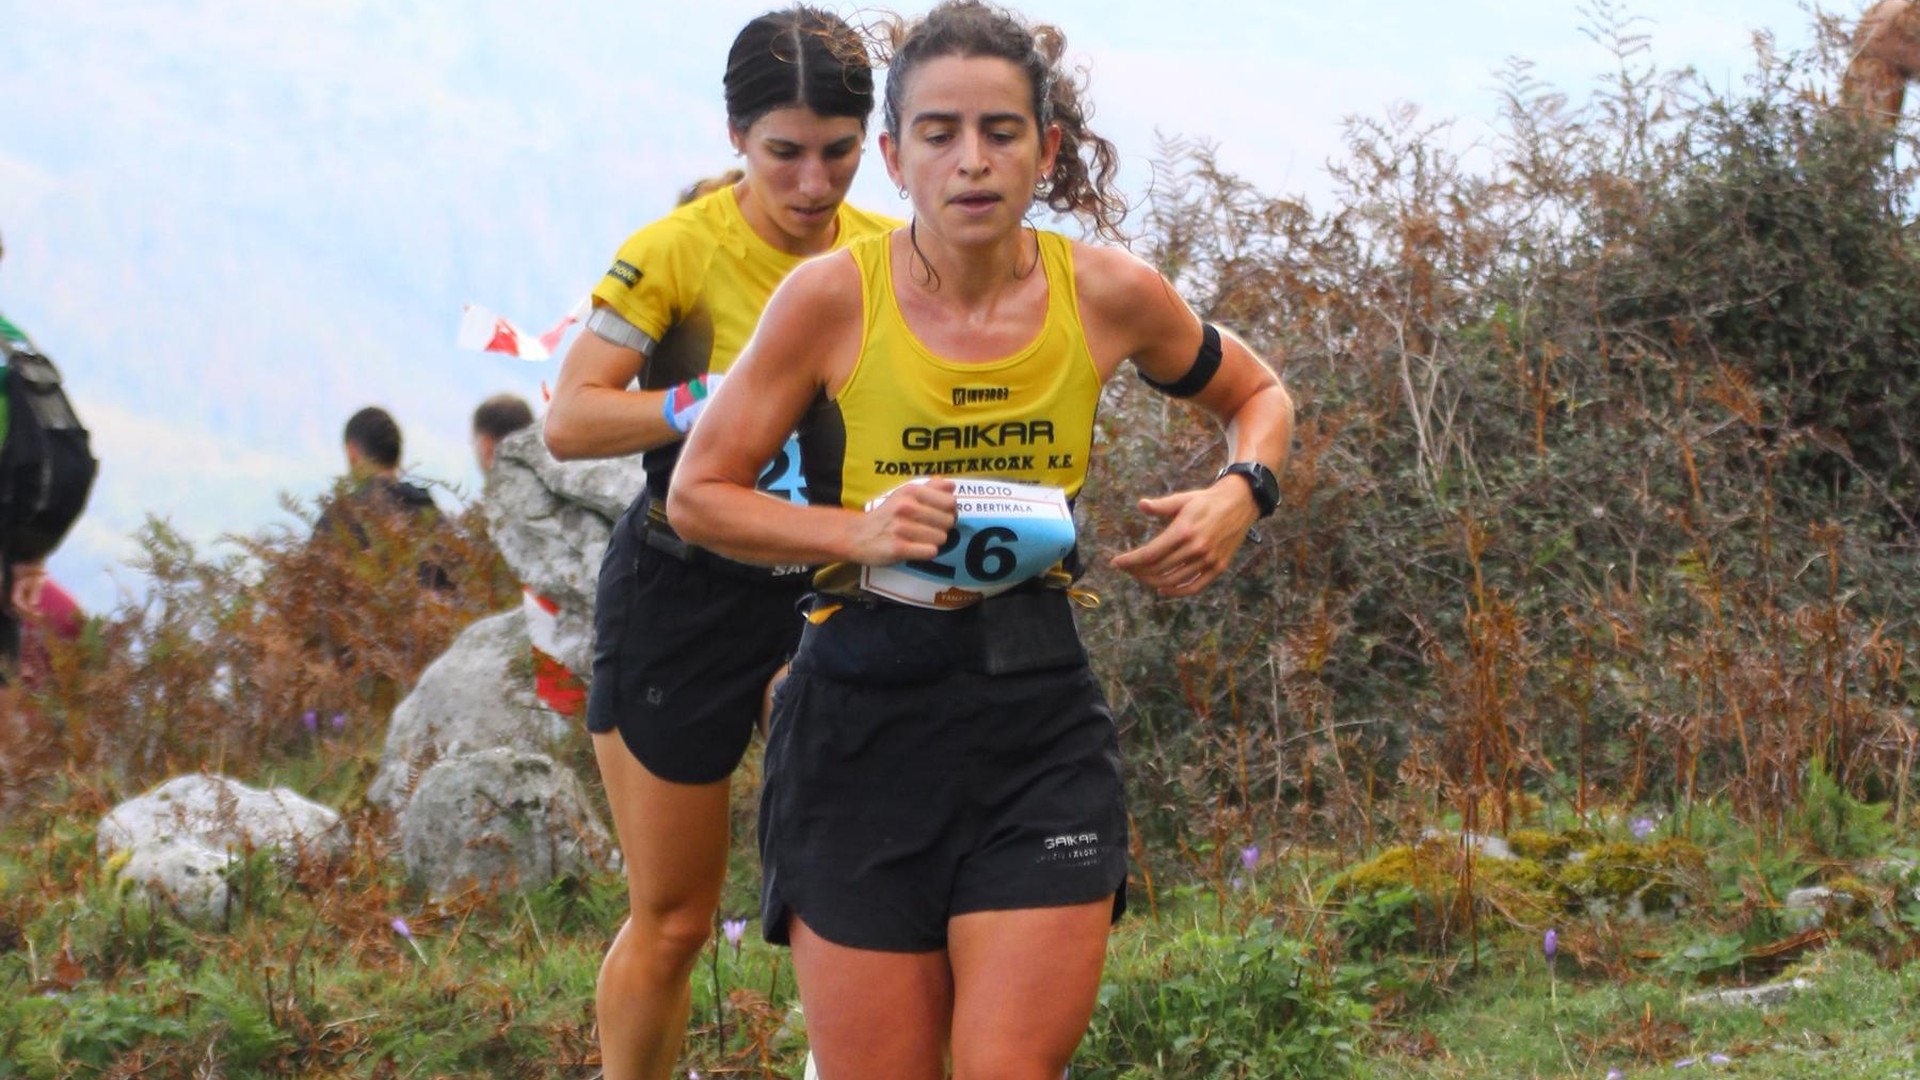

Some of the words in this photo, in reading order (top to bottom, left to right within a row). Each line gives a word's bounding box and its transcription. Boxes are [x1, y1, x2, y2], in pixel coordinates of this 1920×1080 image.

[902, 420, 1054, 451] GAIKAR
[874, 455, 1035, 476] ZORTZIETAKOAK
[958, 485, 1012, 496] ANBOTO
[976, 503, 1033, 513] BERTIKALA
[906, 526, 1019, 582] 26
[1044, 833, 1098, 849] GAIKAR
